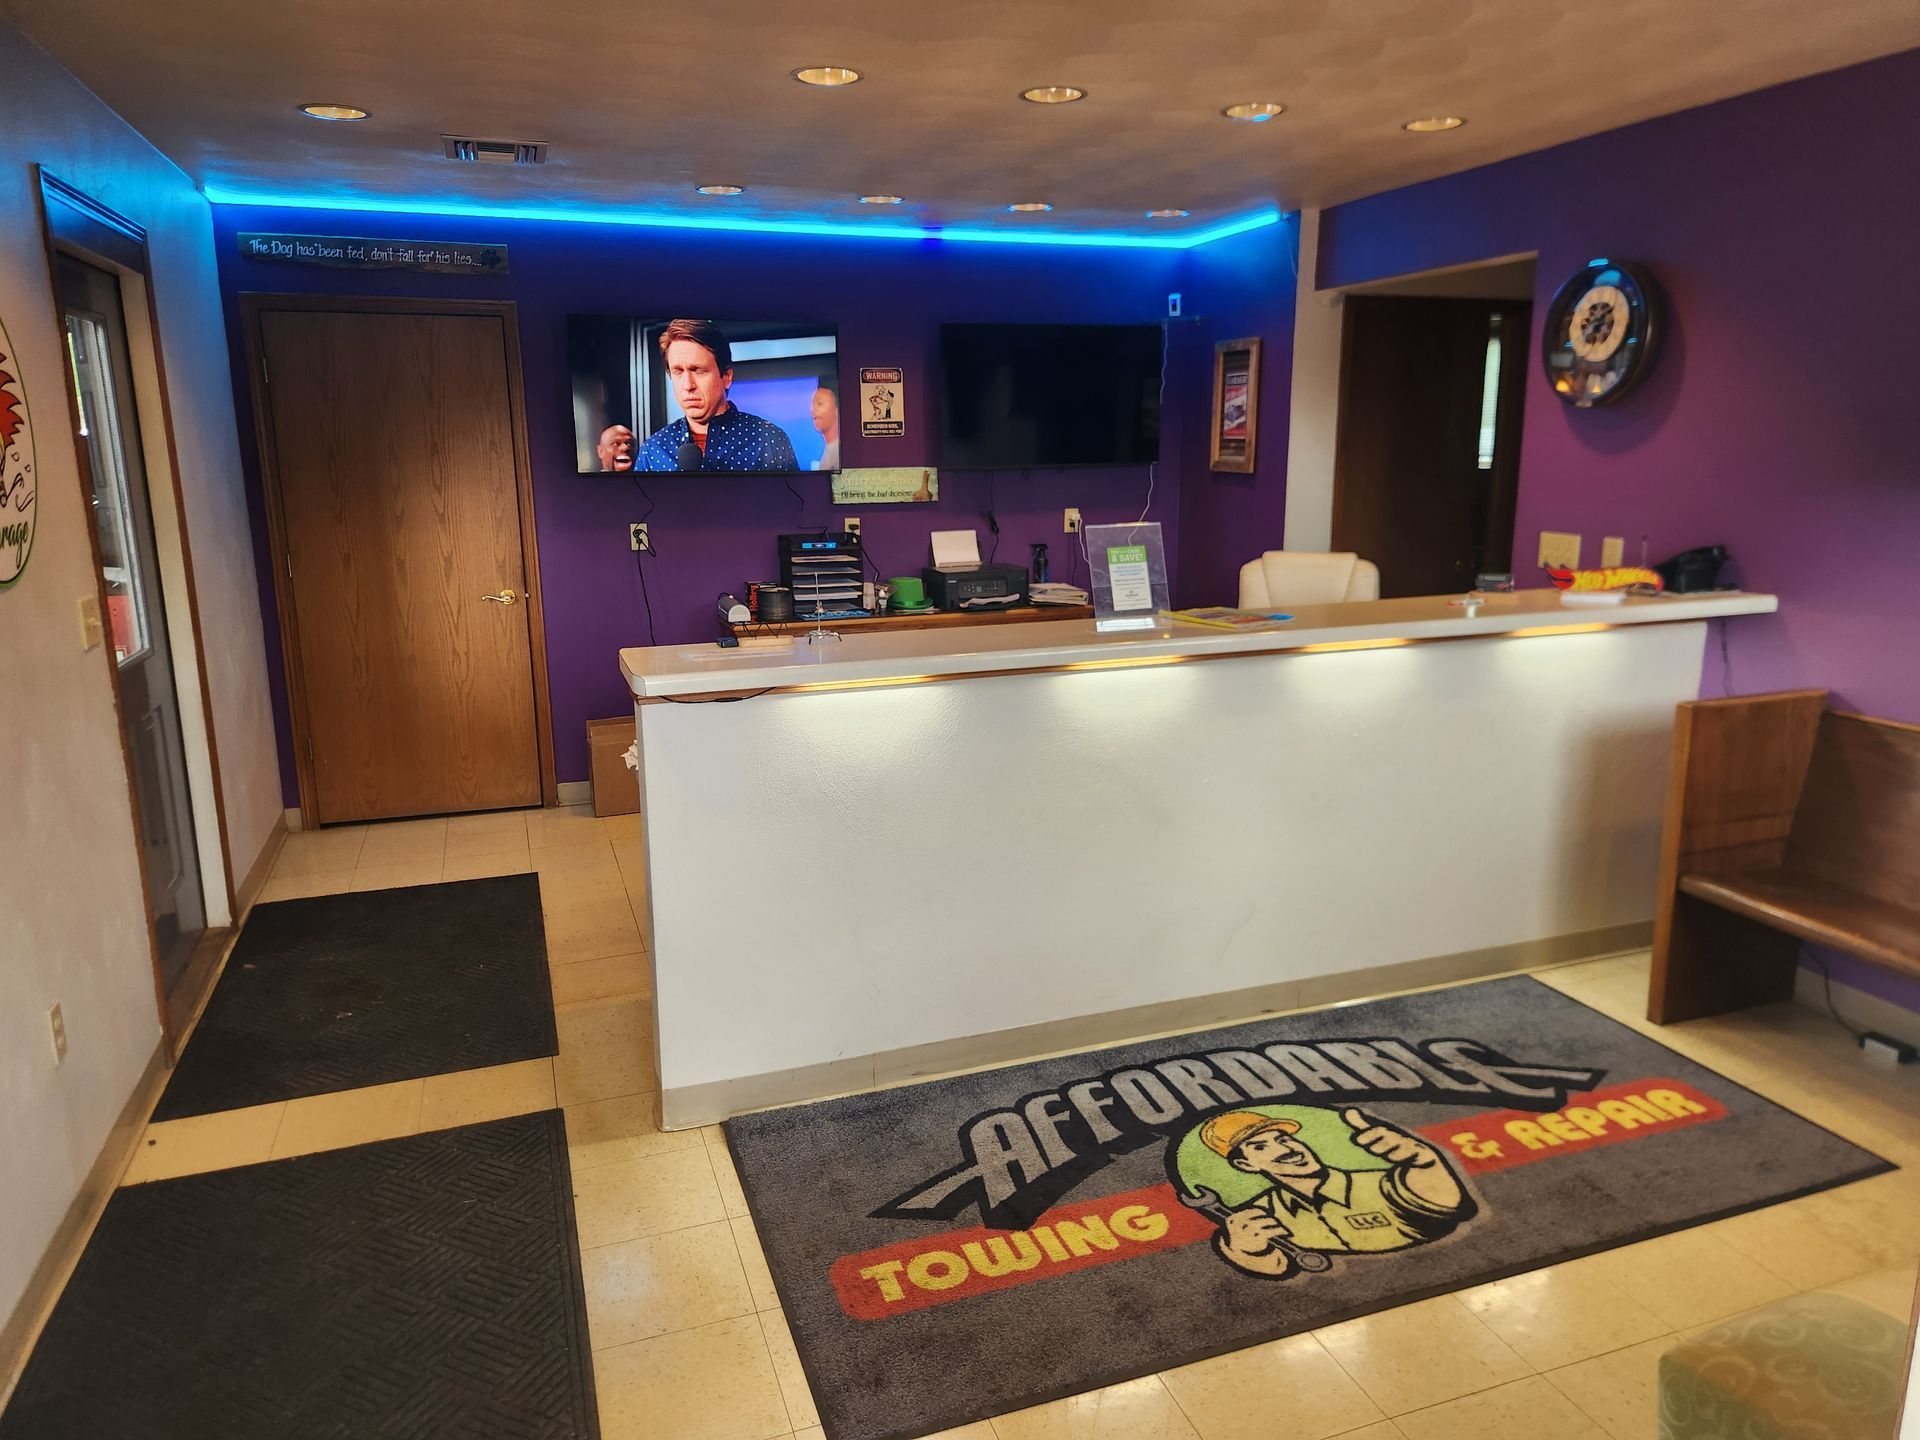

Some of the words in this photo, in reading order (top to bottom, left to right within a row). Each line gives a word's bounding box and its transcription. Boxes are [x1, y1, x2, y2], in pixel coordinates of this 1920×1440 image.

[248, 239, 269, 255] The
[270, 240, 293, 258] Dog
[296, 242, 316, 256] has
[318, 244, 344, 258] been
[347, 246, 368, 261] fed,
[370, 247, 394, 261] don't
[396, 248, 414, 262] fall
[417, 250, 433, 263] for
[435, 251, 451, 264] his
[866, 372, 898, 382] WARNING
[0, 521, 28, 569] rage
[1119, 552, 1143, 562] SAVE!
[890, 1037, 1594, 1210] AFFORDABLE
[1450, 1131, 1505, 1159] &
[1503, 1088, 1707, 1151] REPAIR
[1351, 1215, 1385, 1226] LLC
[859, 1205, 1169, 1302] TOWING
